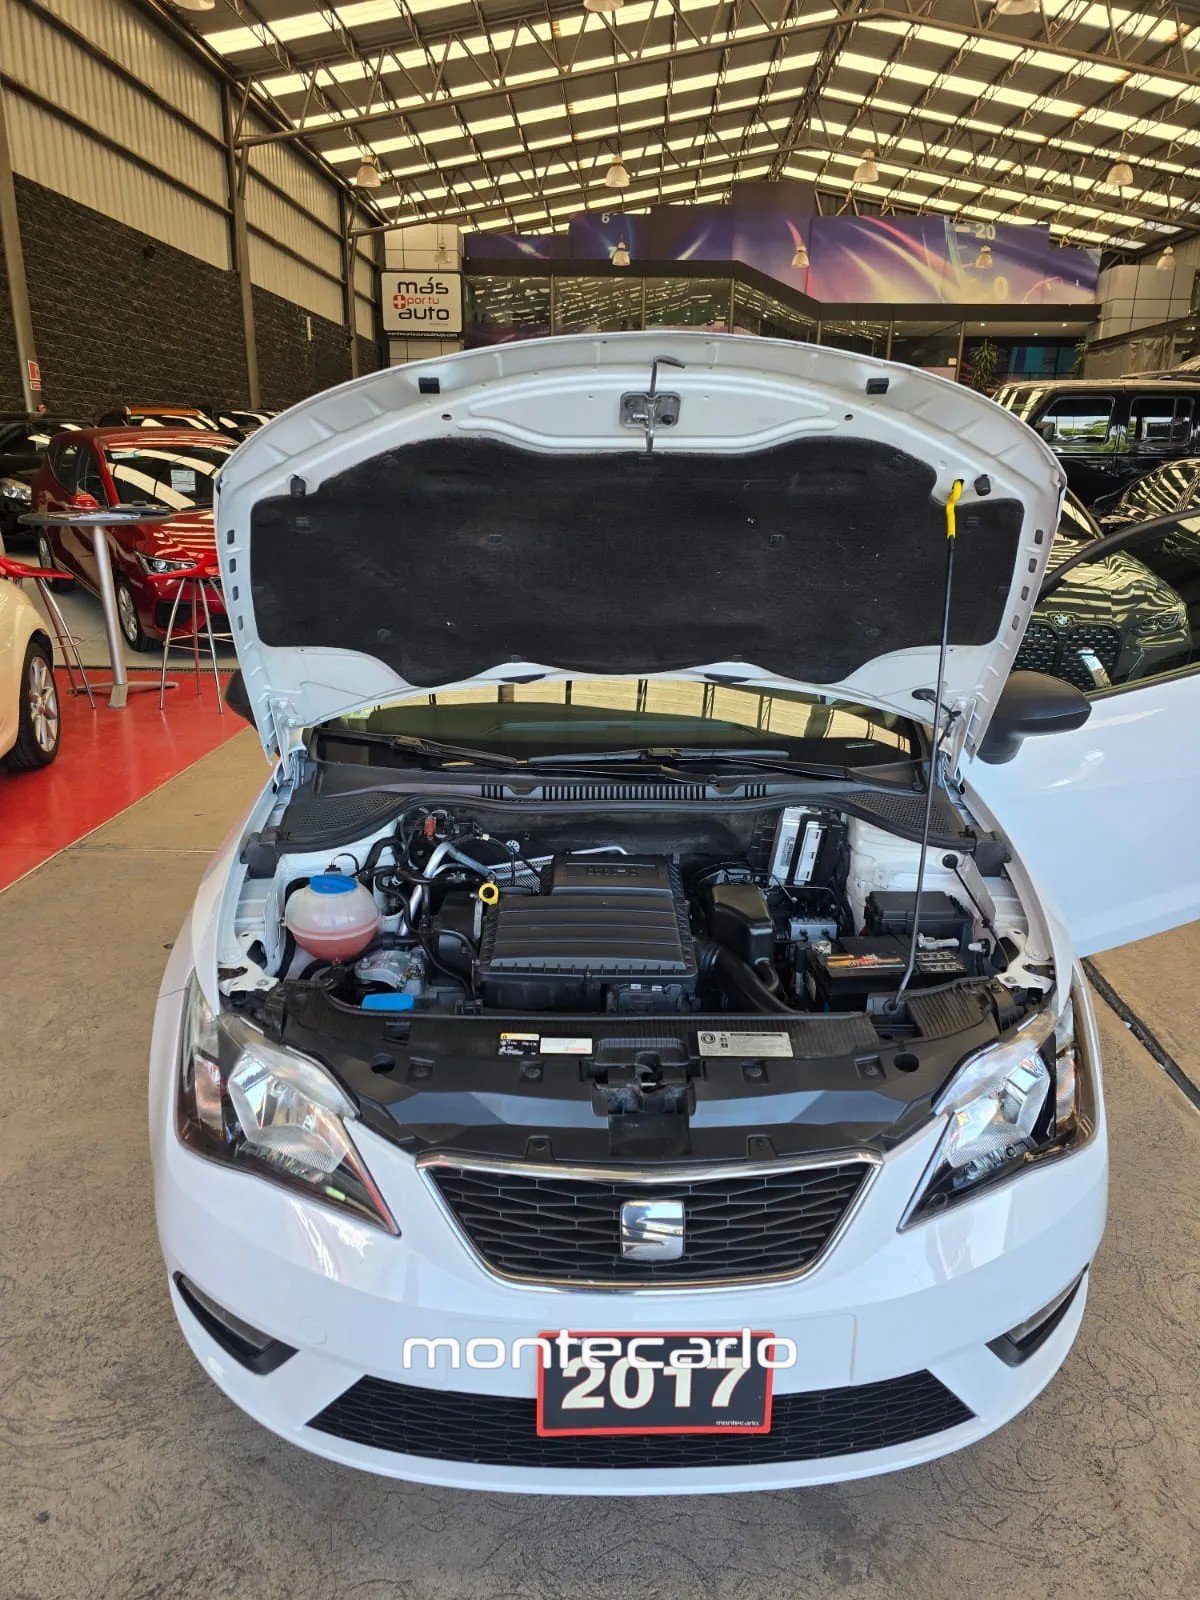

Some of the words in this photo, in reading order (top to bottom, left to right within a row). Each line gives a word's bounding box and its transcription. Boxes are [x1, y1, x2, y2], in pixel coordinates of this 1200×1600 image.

[975, 223, 996, 240] 20
[397, 276, 449, 294] más
[994, 276, 1009, 299] 0
[407, 297, 425, 306] por
[428, 296, 440, 305] tu
[398, 306, 450, 321] auto
[561, 1356, 751, 1409] 2017
